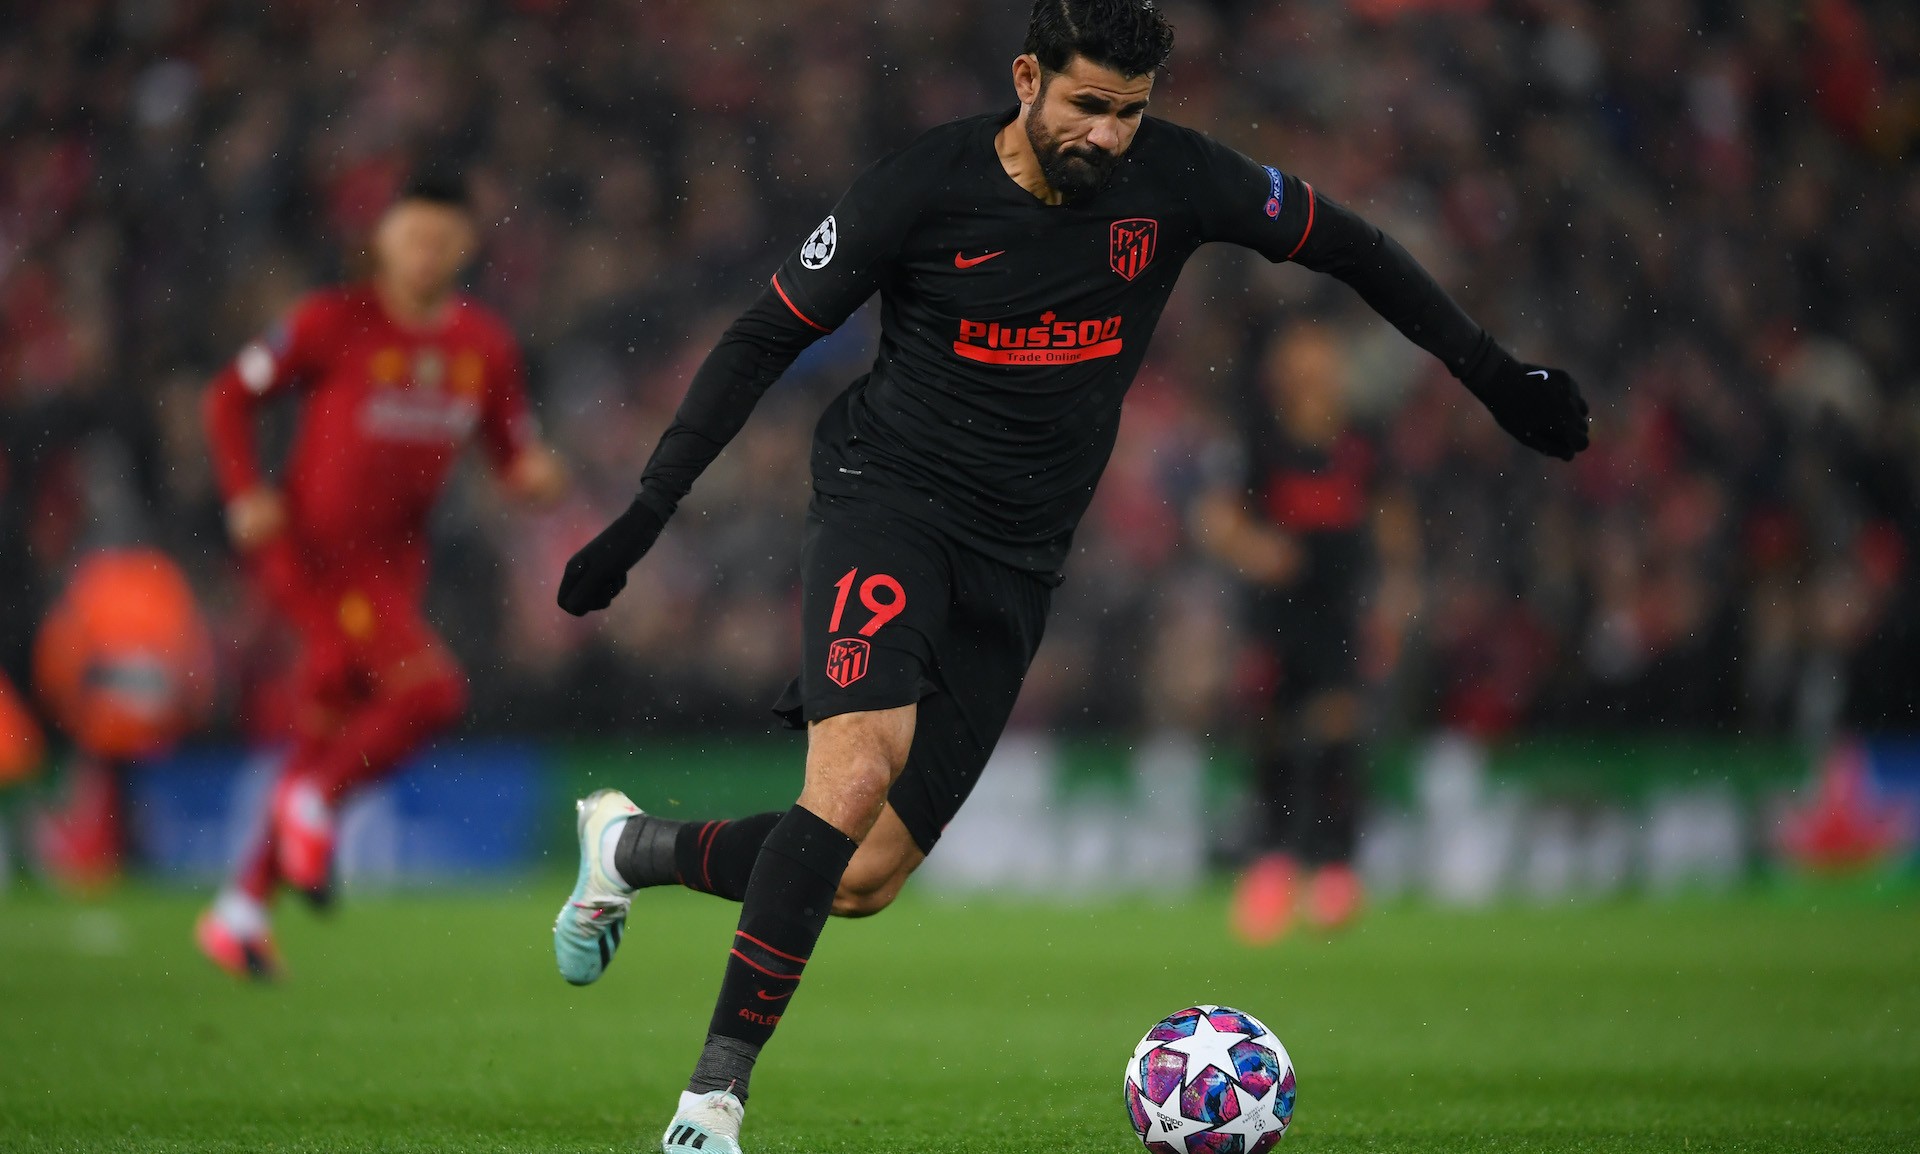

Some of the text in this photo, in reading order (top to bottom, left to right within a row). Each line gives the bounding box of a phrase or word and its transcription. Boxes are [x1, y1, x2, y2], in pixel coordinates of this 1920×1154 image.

[960, 313, 1122, 349] Plus500
[1007, 352, 1082, 362] Trade Online
[828, 567, 907, 637] 19
[1157, 1111, 1183, 1126] adidas
